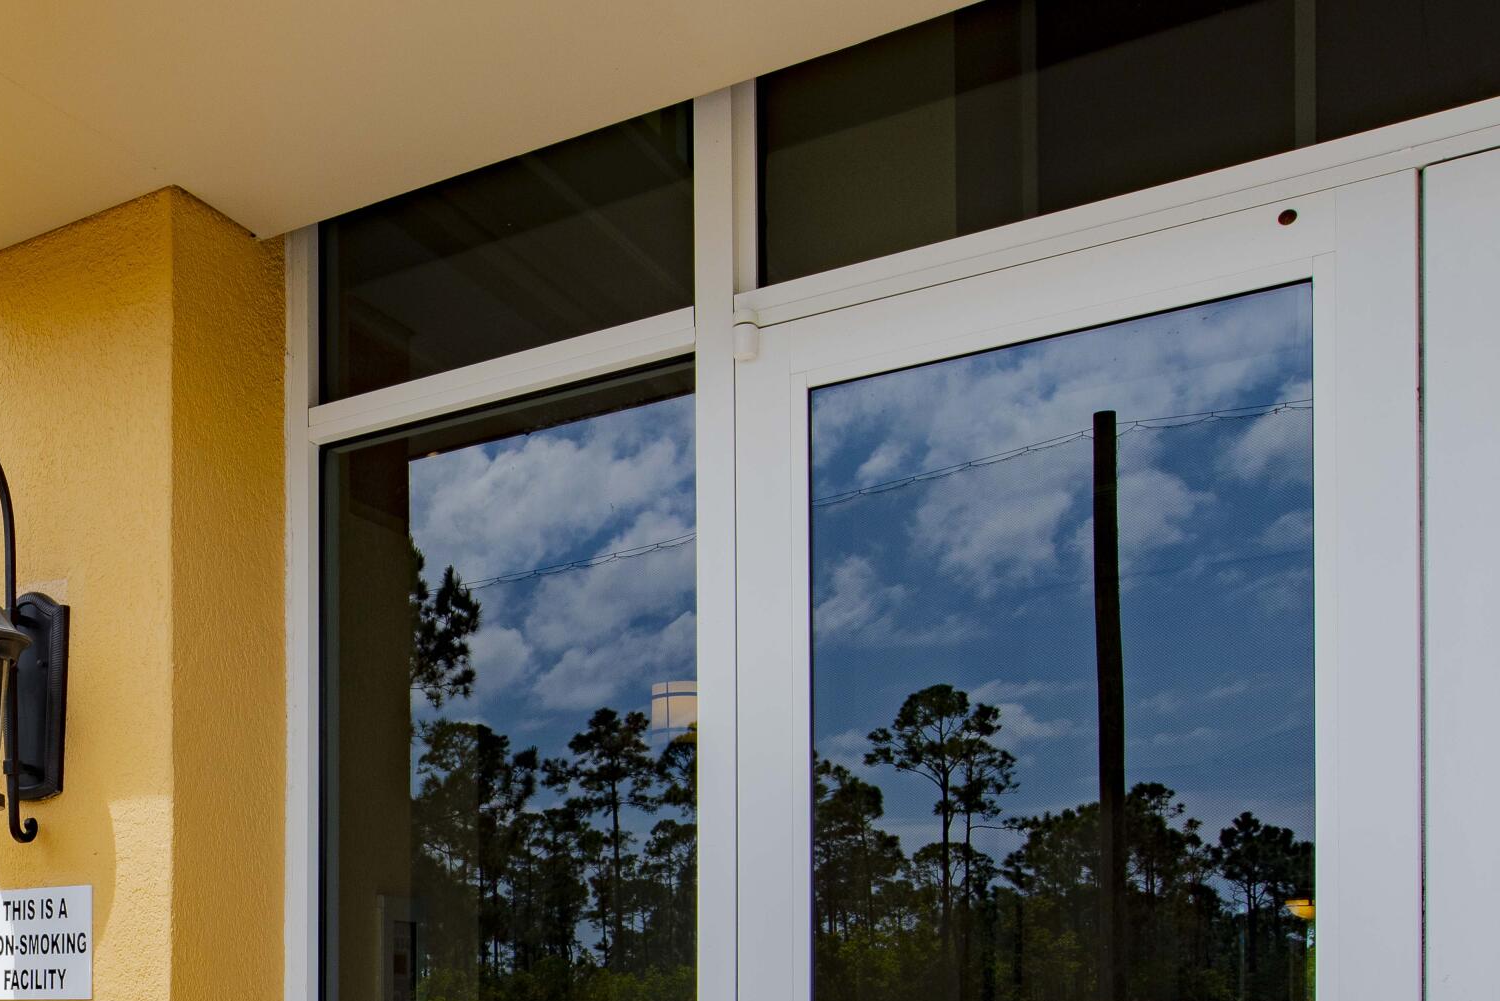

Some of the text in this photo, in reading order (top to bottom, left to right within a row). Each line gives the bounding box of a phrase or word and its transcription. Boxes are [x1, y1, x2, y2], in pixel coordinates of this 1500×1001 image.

[3, 897, 68, 921] THIS IS A
[4, 968, 67, 990] FACILITY
